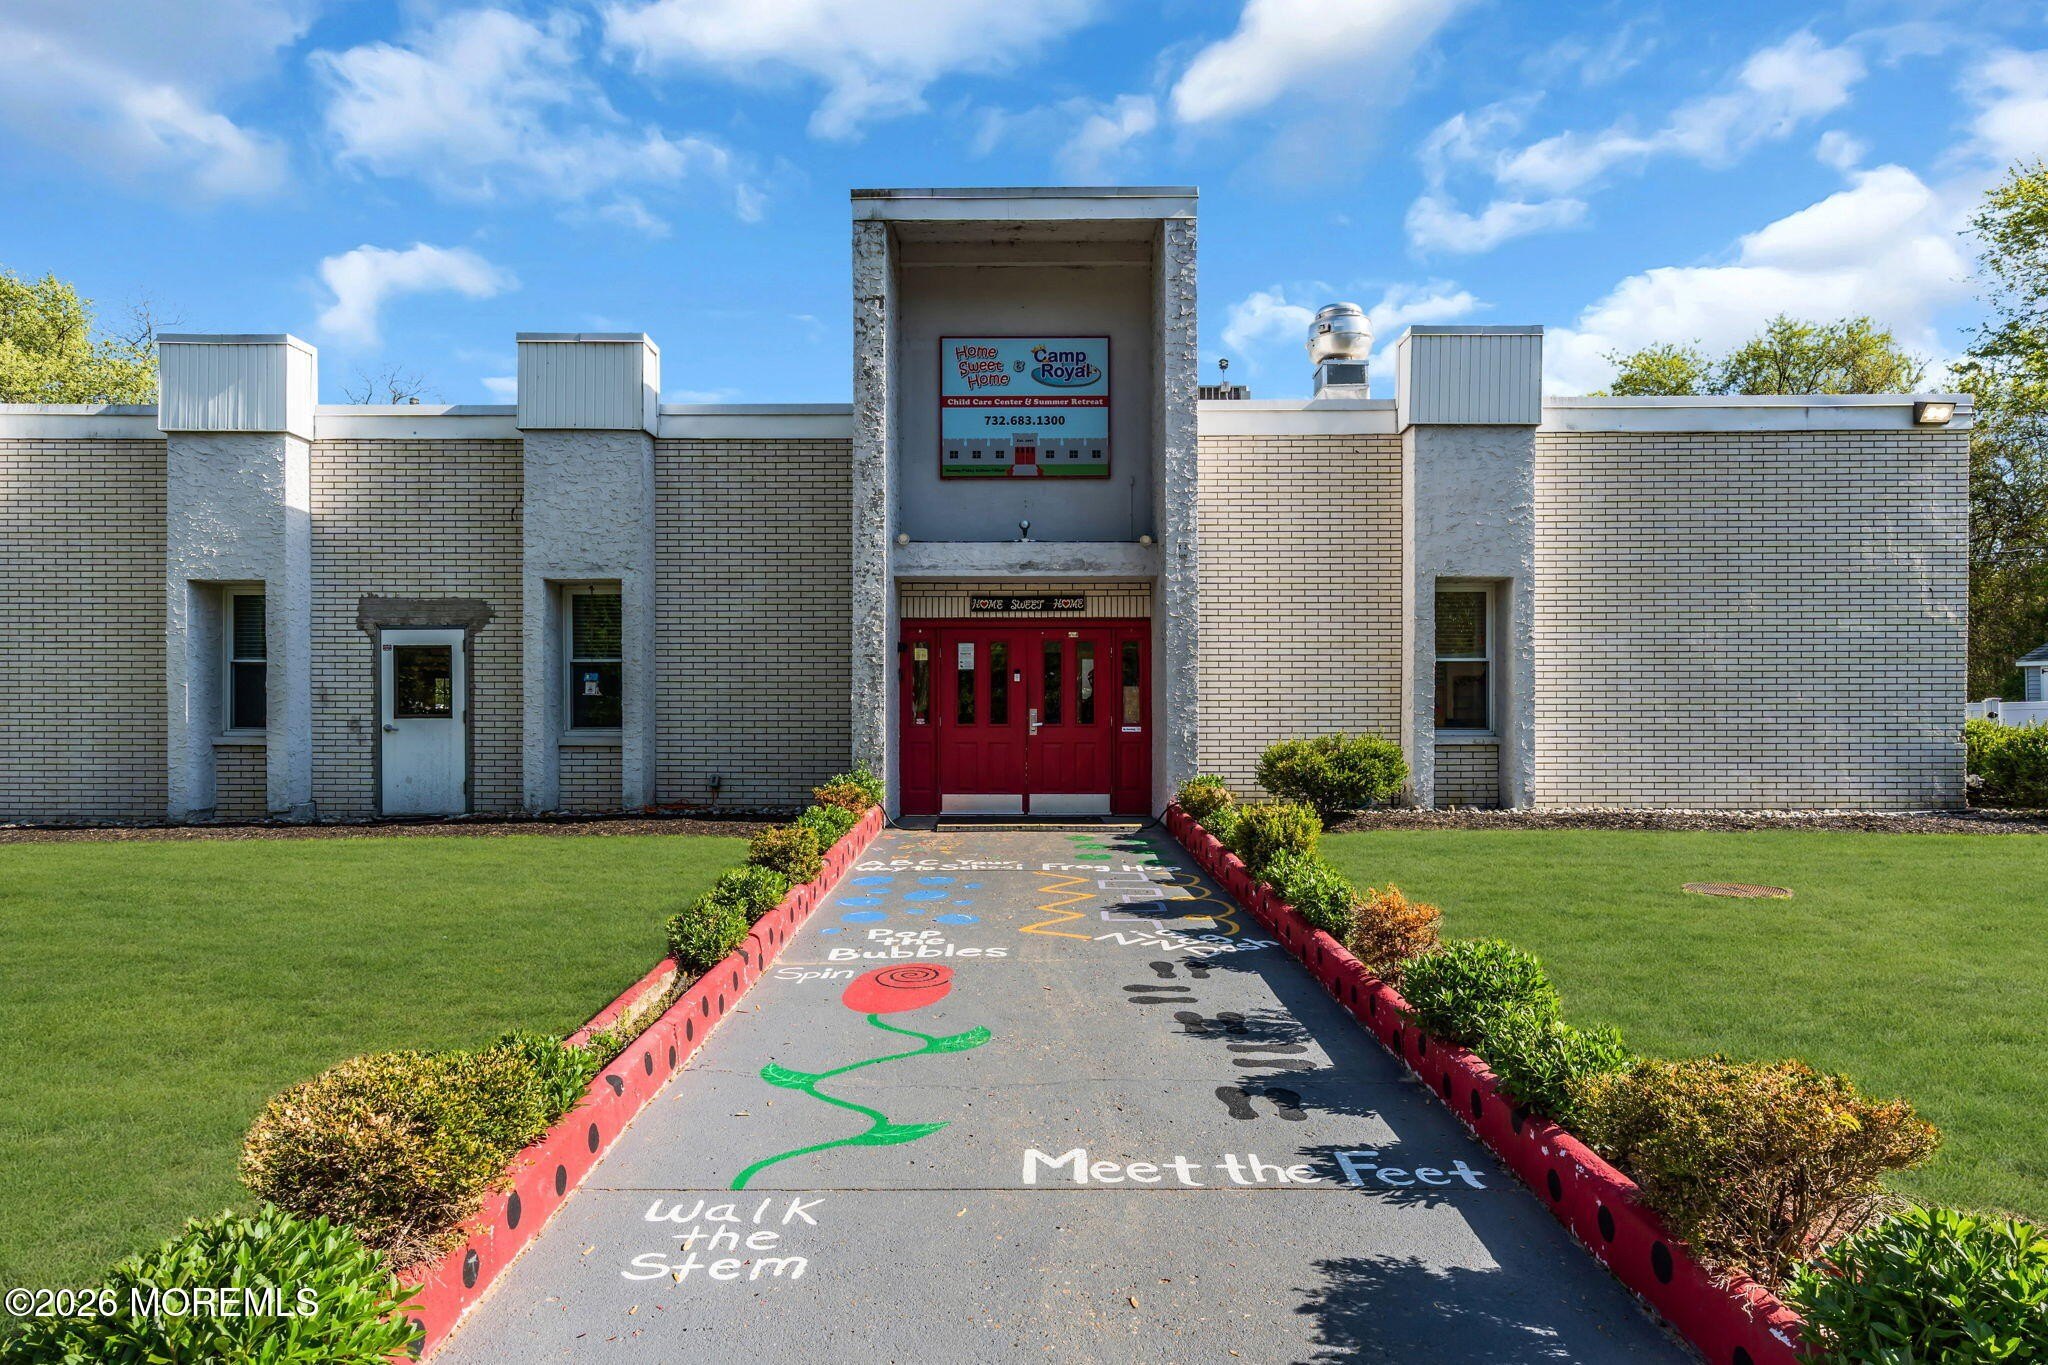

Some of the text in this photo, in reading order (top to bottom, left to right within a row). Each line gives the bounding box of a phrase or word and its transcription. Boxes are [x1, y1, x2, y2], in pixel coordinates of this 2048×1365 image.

[955, 345, 998, 361] Home
[1033, 348, 1087, 366] Camp
[958, 360, 1004, 378] Sweet
[1013, 360, 1025, 372] &
[1041, 363, 1091, 382] Royal
[967, 374, 1010, 390] Home
[947, 398, 1103, 406] Child Care Center & Summer Retreat
[984, 415, 1066, 426] 732.683.1300
[1010, 598, 1045, 610] SWEET
[939, 863, 1024, 871] School
[1042, 862, 1182, 872] Frog Hop
[867, 928, 942, 940] Pop
[875, 935, 946, 946] the
[827, 943, 1008, 961] Bubbles
[1184, 938, 1280, 958] Dash
[774, 966, 854, 984] Spin
[1022, 1147, 1488, 1190] Meet the Feet
[671, 1223, 780, 1251] the
[620, 1252, 808, 1283] Stem
